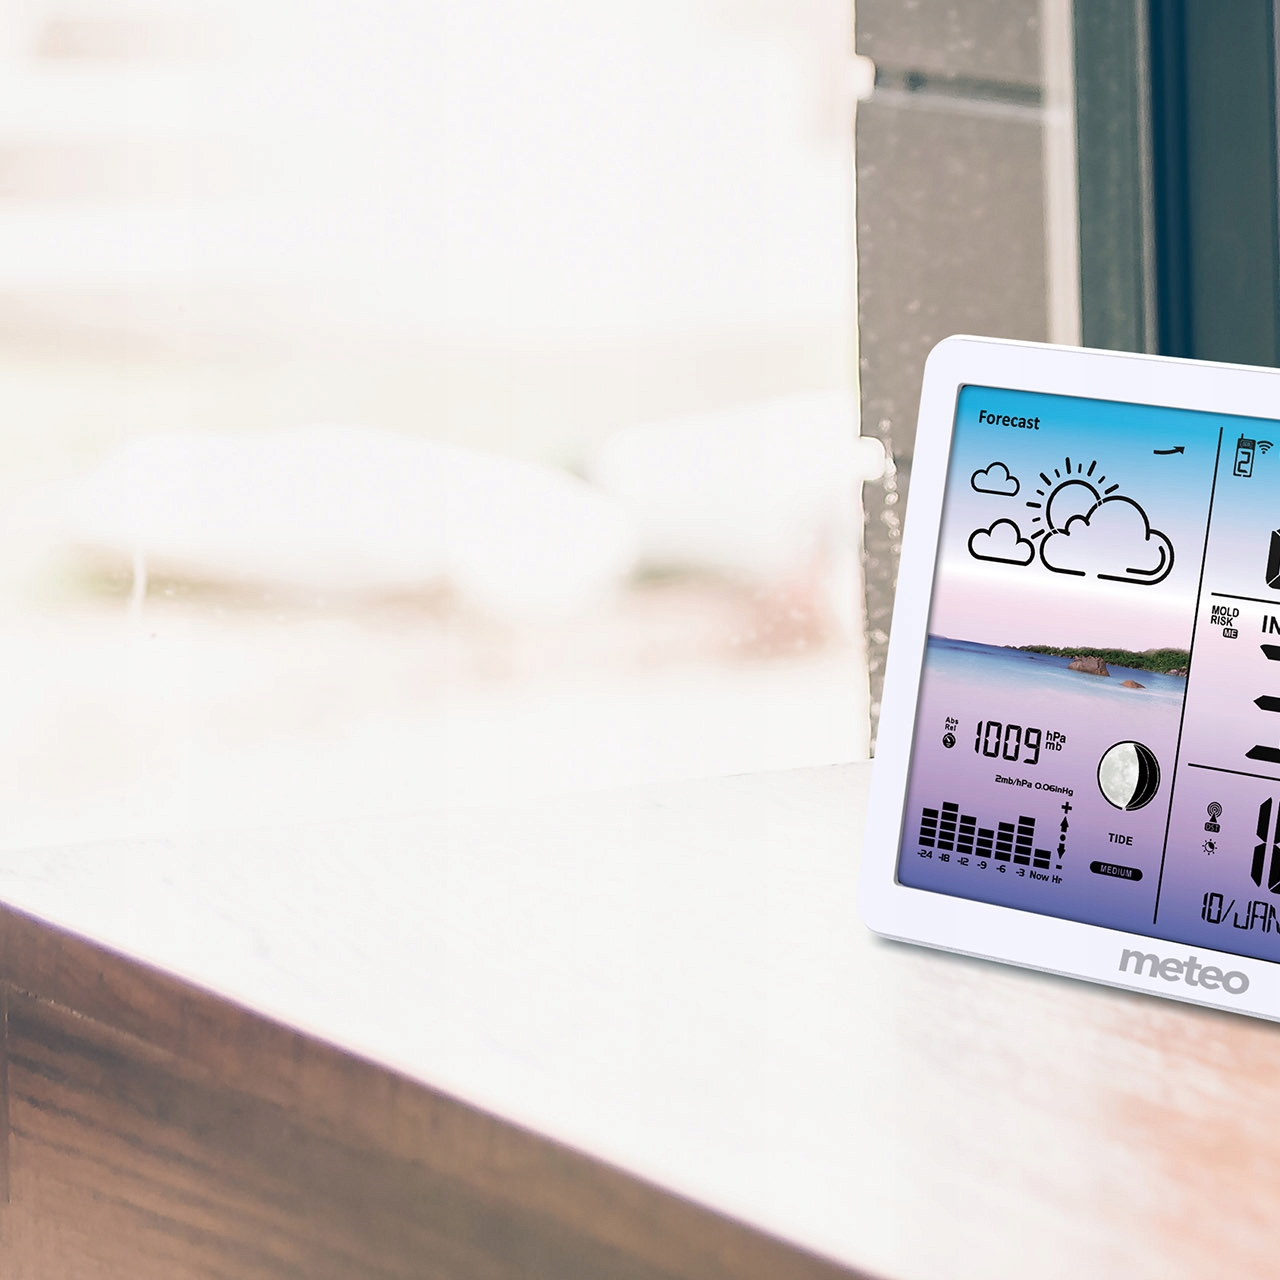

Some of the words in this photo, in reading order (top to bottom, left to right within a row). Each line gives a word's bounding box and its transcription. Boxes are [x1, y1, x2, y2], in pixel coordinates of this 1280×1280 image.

[978, 409, 1041, 430] Forecast
[1211, 604, 1240, 618] MOLD
[1210, 614, 1234, 627] RISK
[944, 723, 957, 732] Rel
[945, 716, 959, 725] Abs
[974, 720, 1043, 765] 1009
[1045, 730, 1067, 744] hPa
[1045, 740, 1063, 752] mb
[995, 774, 1033, 789] 2mb/hPa
[1107, 832, 1134, 847] TIDE
[917, 849, 933, 860] -24
[976, 860, 988, 870] -9
[996, 864, 1007, 874] -6
[1015, 868, 1026, 878] -3
[1029, 870, 1050, 883] Now
[1051, 874, 1063, 885] Hr
[1099, 864, 1133, 879] MEDIUM
[1117, 947, 1251, 995] meteo
